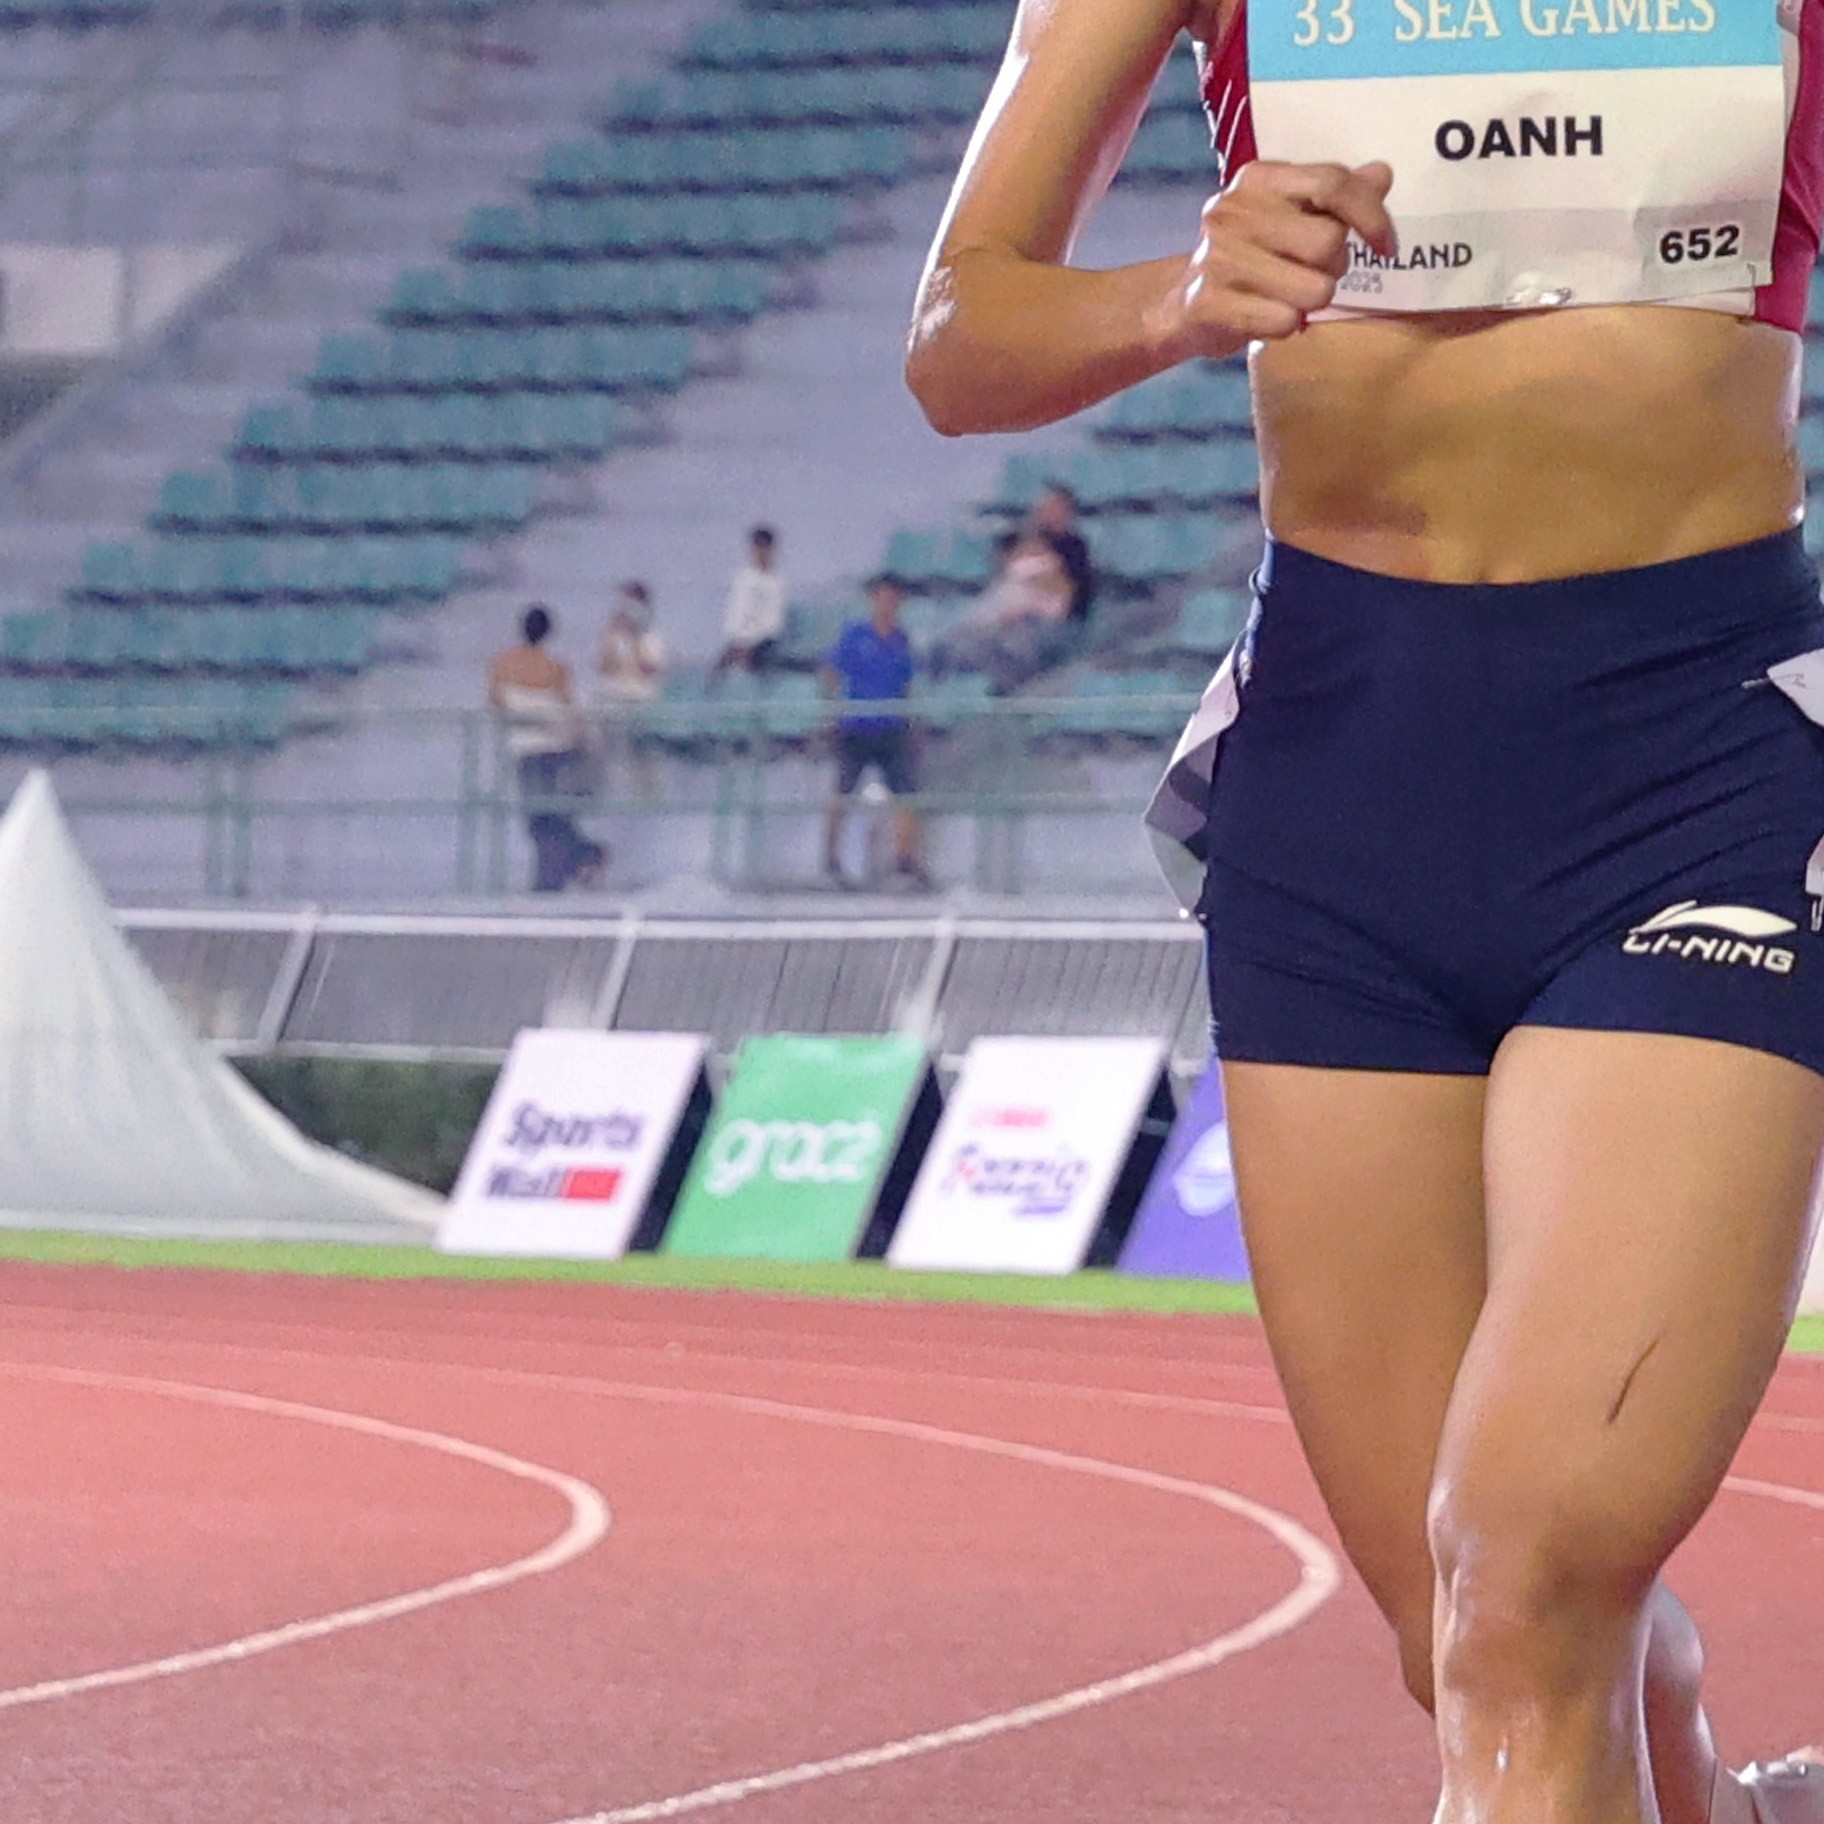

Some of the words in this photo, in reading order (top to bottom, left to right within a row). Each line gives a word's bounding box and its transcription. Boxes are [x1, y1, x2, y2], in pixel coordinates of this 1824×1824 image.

[1434, 115, 1604, 161] OANH
[1658, 224, 1741, 265] 652
[1622, 933, 1796, 973] LI-NING
